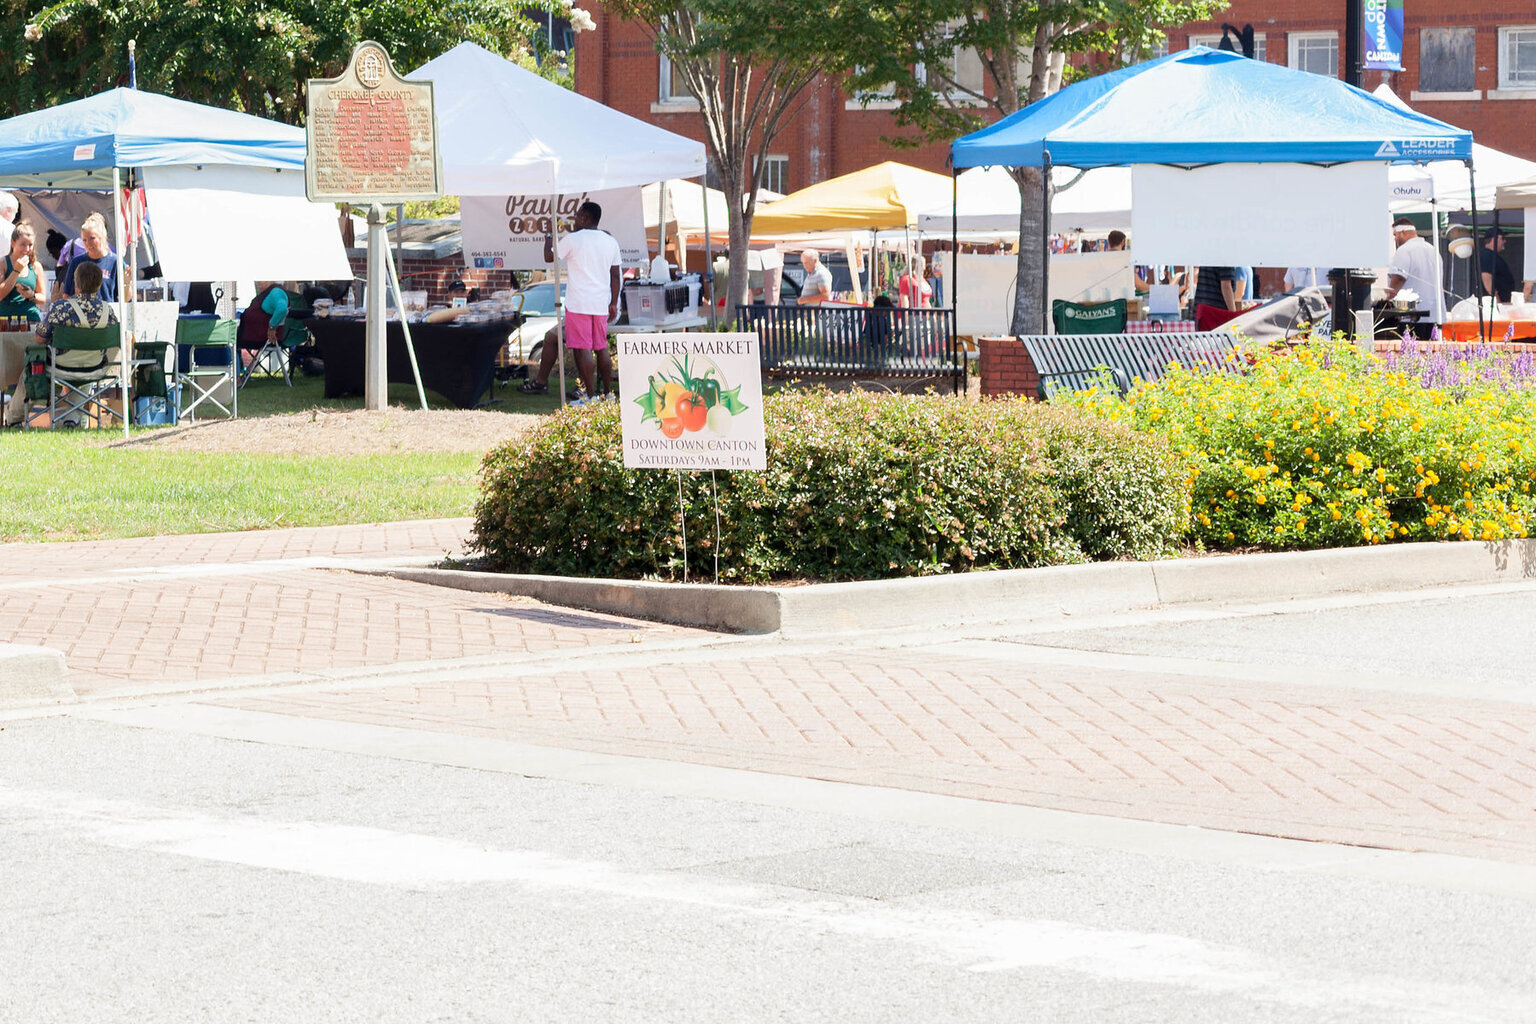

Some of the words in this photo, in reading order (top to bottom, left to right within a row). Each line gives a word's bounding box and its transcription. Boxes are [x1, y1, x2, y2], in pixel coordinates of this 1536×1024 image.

[1366, 50, 1400, 62] CANTON
[328, 89, 374, 100] CHEROKEE
[379, 89, 414, 101] COUNTY
[1401, 139, 1455, 148] LEADER
[1393, 186, 1421, 195] Ohuhu
[505, 192, 590, 216] Paula'
[624, 340, 688, 355] FARMERS
[692, 340, 753, 355] MARKET
[631, 438, 704, 451] DOWNTOWN
[707, 439, 757, 452] CANTON
